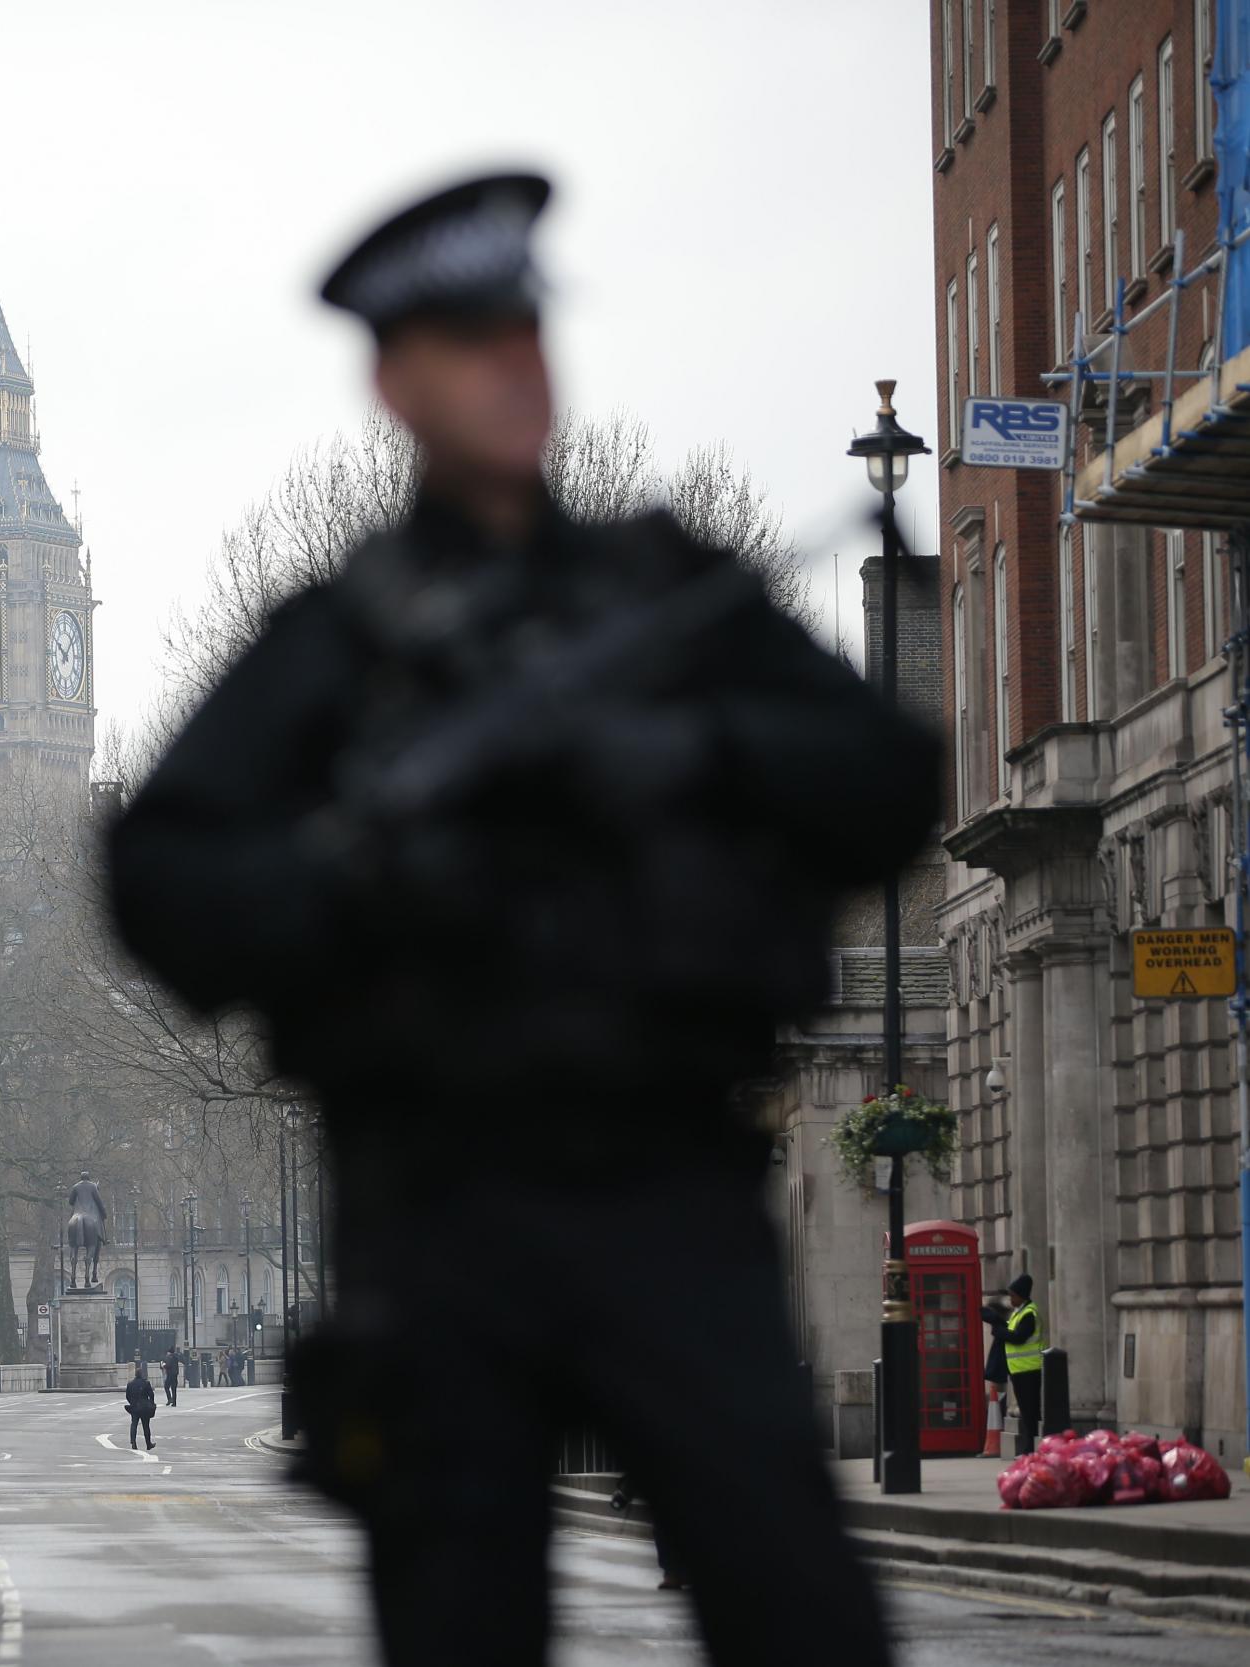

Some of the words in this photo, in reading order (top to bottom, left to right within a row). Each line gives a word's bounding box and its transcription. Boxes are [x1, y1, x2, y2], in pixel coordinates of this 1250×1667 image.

[972, 402, 1060, 440] RBS
[970, 453, 999, 463] 0800
[1003, 454, 1025, 464] 019
[1030, 455, 1058, 465] 3981
[1137, 934, 1194, 945] DANGER
[1200, 933, 1230, 943] MEN
[1150, 945, 1217, 956] WORKING
[1145, 957, 1222, 968] OVERHEAD
[911, 1246, 967, 1255] TELEPHONE
